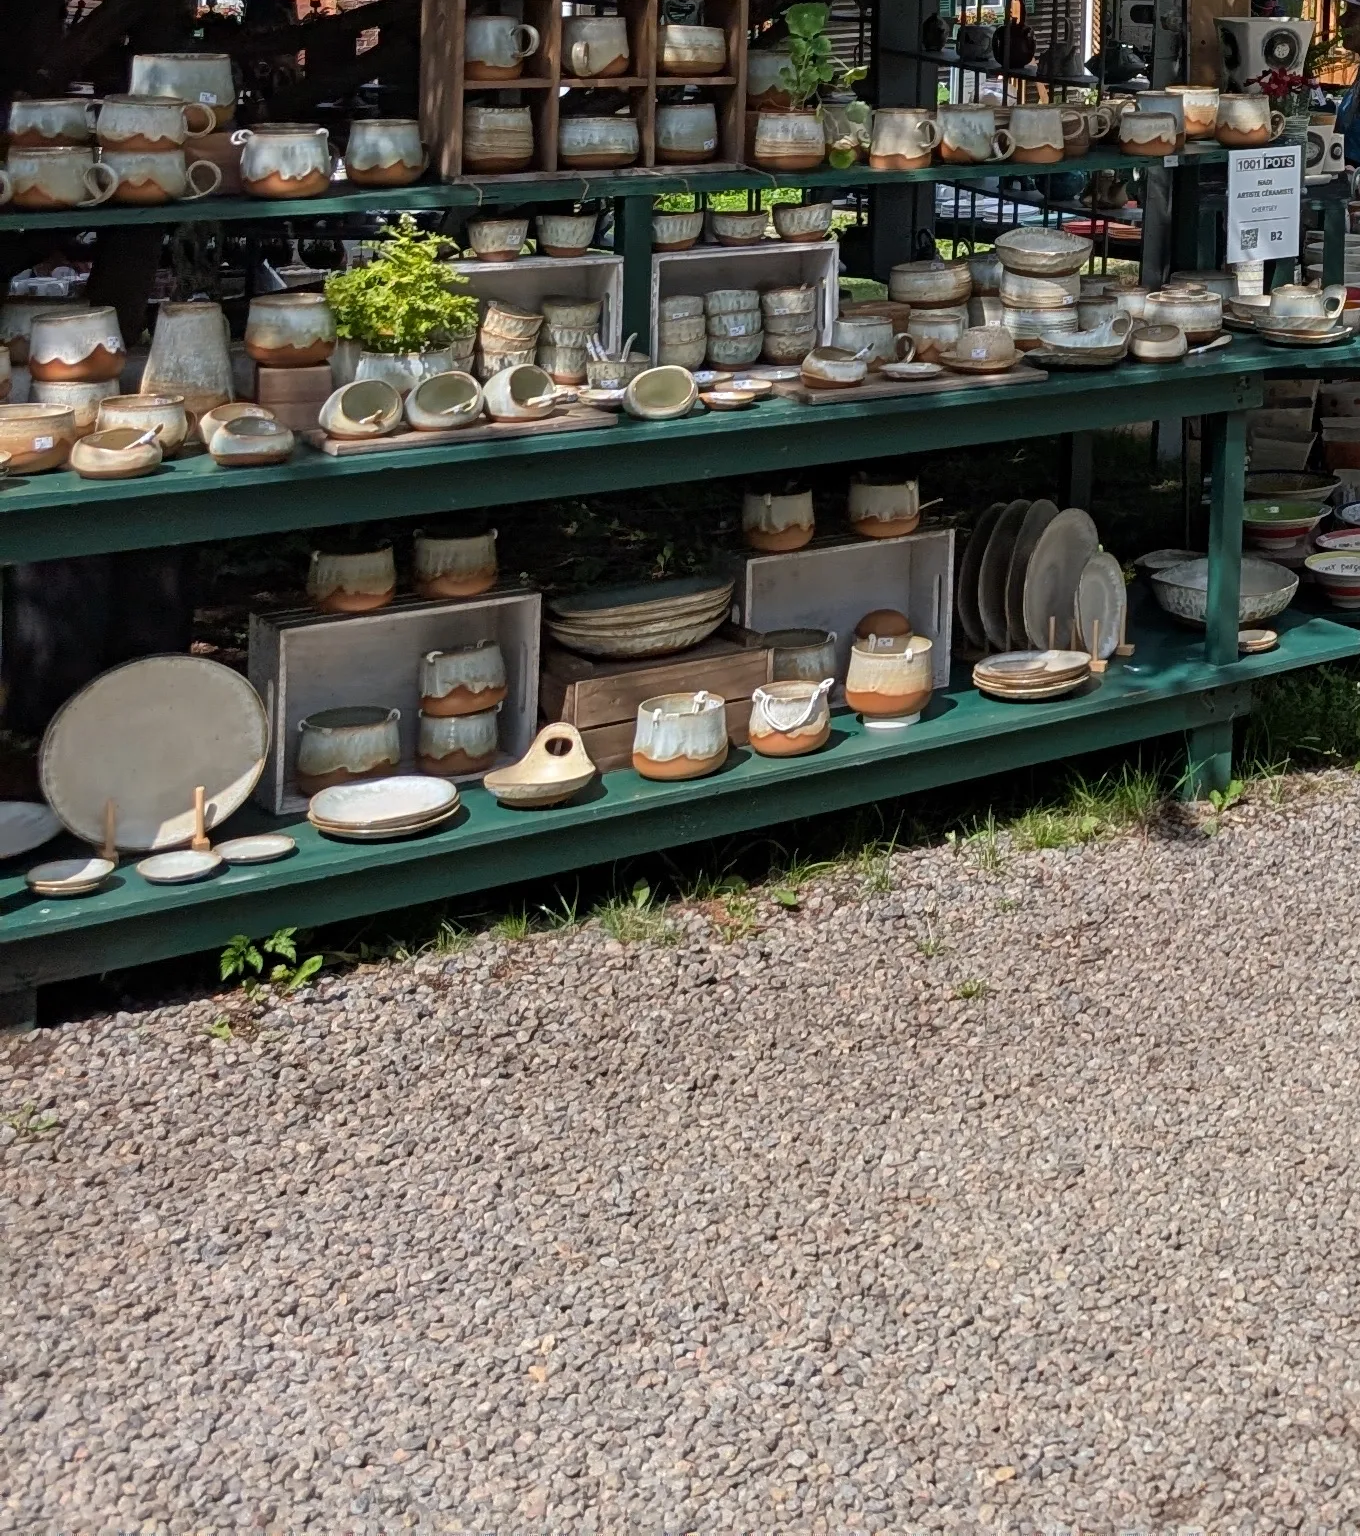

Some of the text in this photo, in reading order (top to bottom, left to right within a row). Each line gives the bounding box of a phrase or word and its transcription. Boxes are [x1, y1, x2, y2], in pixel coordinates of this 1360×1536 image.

[1238, 156, 1294, 170] 1001 POTS
[1237, 191, 1261, 199] ARTISTE
[1270, 231, 1283, 241] B2
